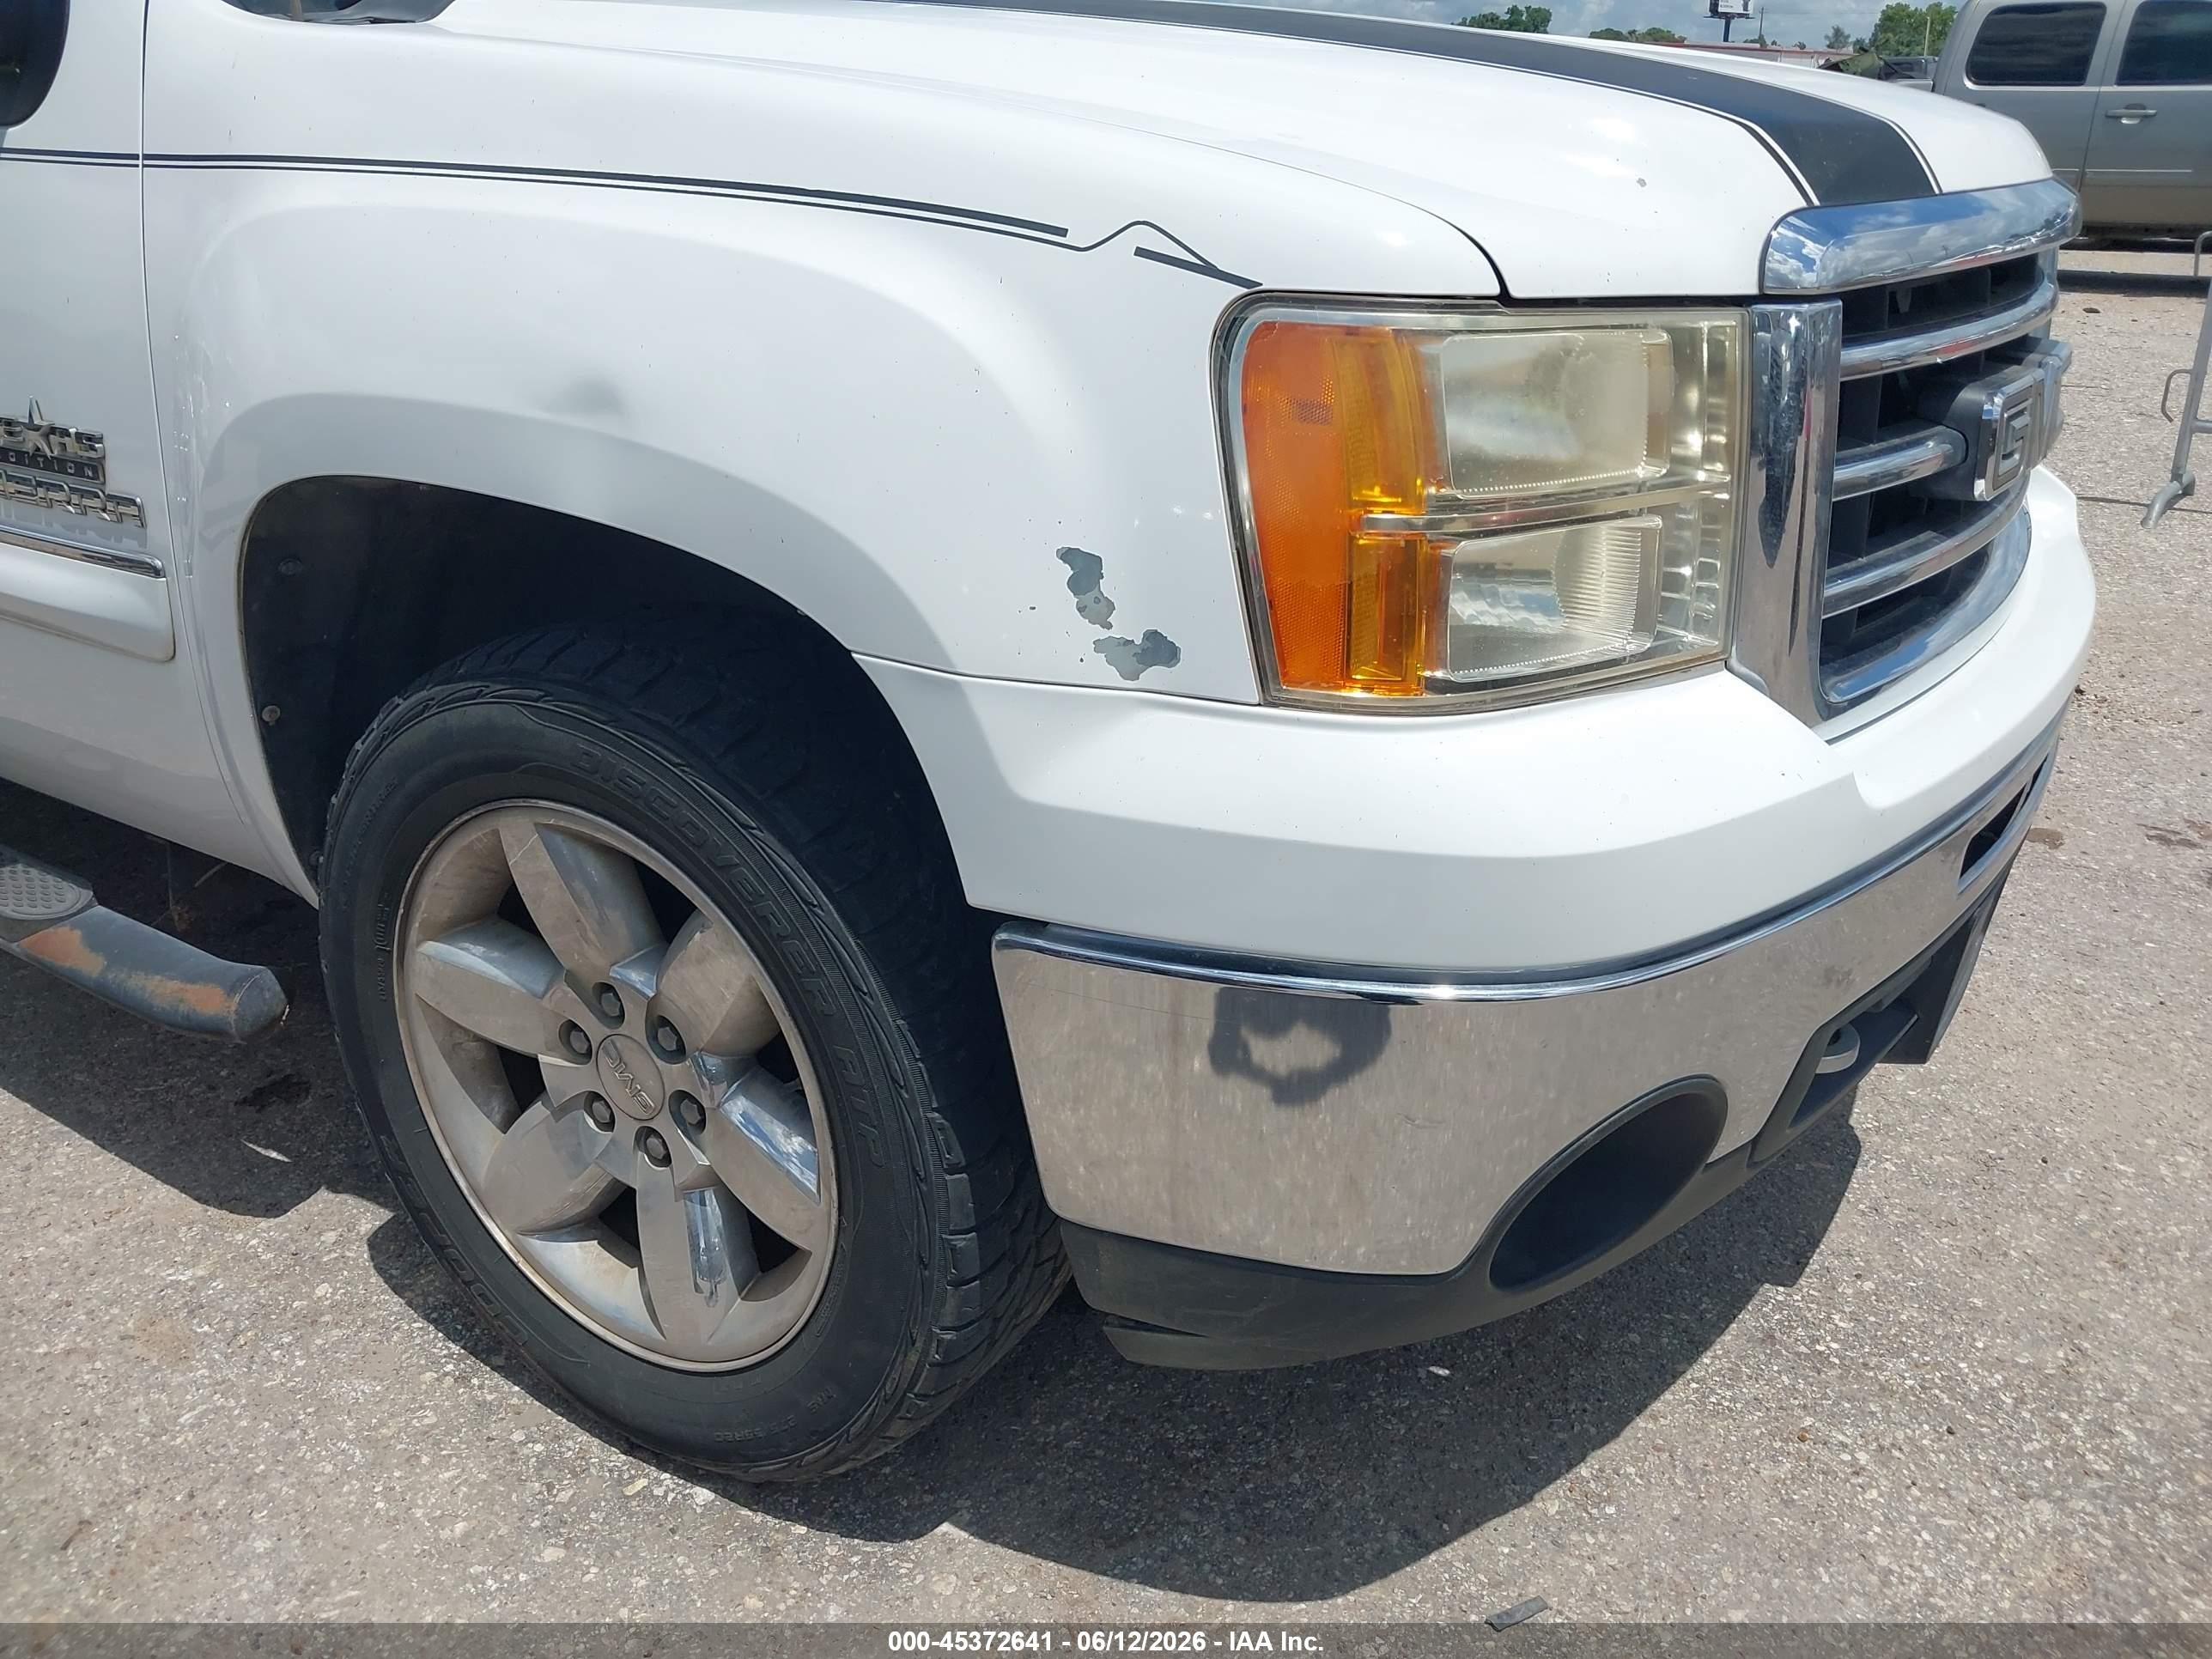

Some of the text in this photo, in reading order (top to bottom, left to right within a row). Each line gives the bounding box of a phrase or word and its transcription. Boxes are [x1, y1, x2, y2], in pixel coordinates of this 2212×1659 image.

[0, 397, 105, 459] EXAS
[0, 451, 94, 477] DITION
[0, 470, 147, 530] IERRA
[570, 741, 838, 1020] DISCOVERER
[601, 1039, 656, 1115] GMC
